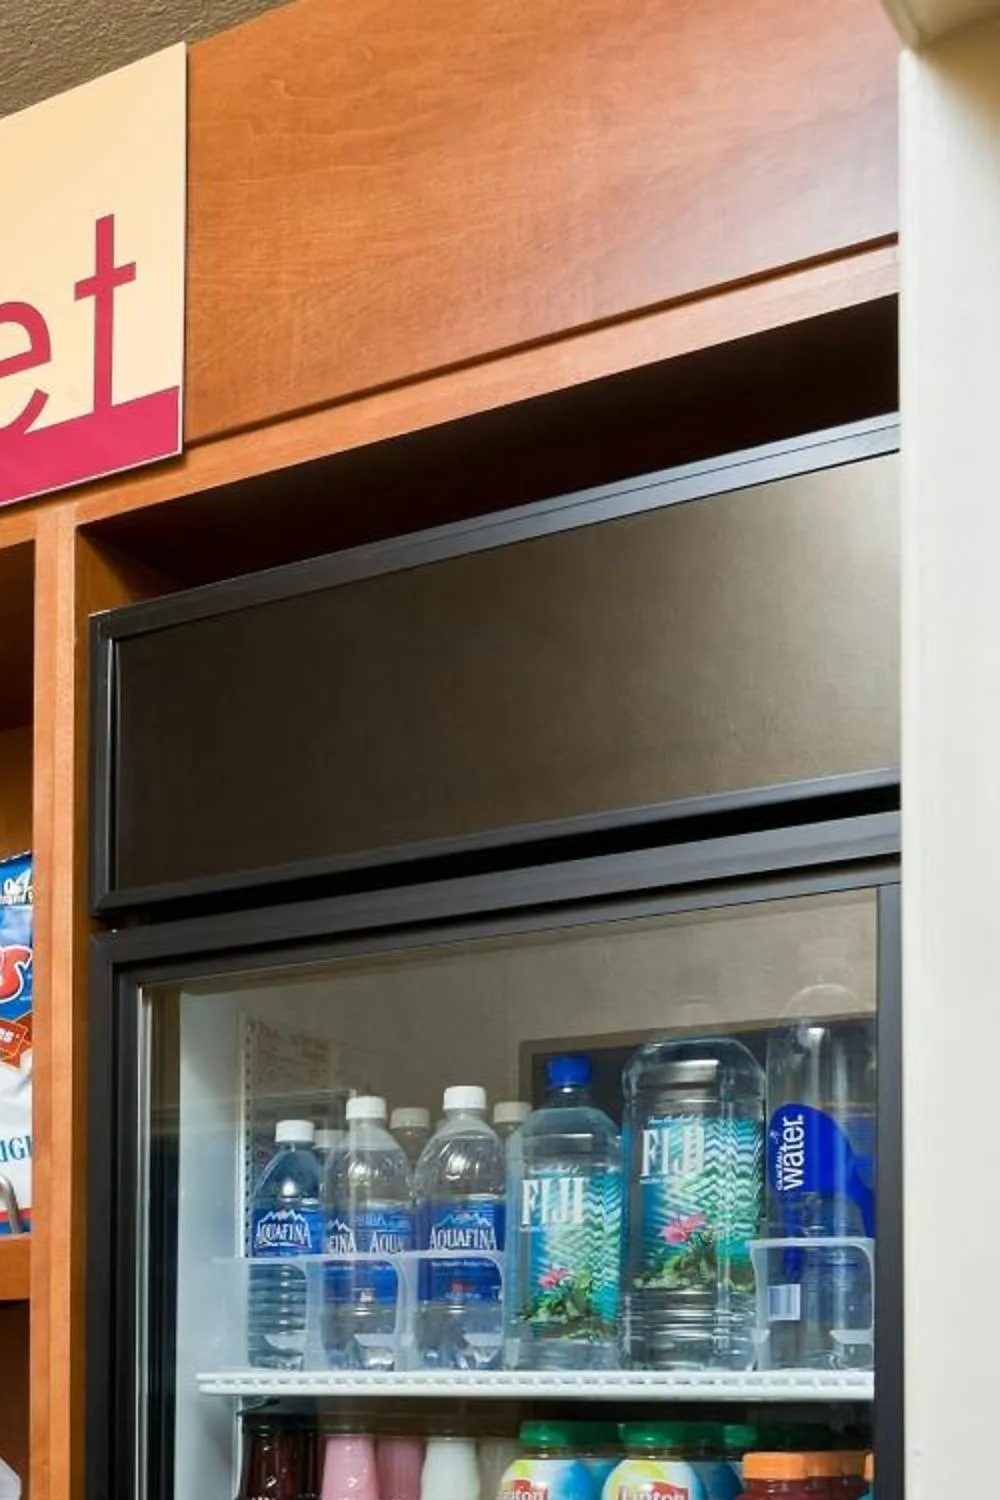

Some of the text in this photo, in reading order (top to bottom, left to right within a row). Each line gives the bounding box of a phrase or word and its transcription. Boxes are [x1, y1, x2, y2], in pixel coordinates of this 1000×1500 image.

[642, 1128, 705, 1177] FIJI
[521, 1176, 585, 1227] FIJI
[254, 1219, 313, 1249] AQUAFINA
[429, 1225, 498, 1251] AQUAFINA
